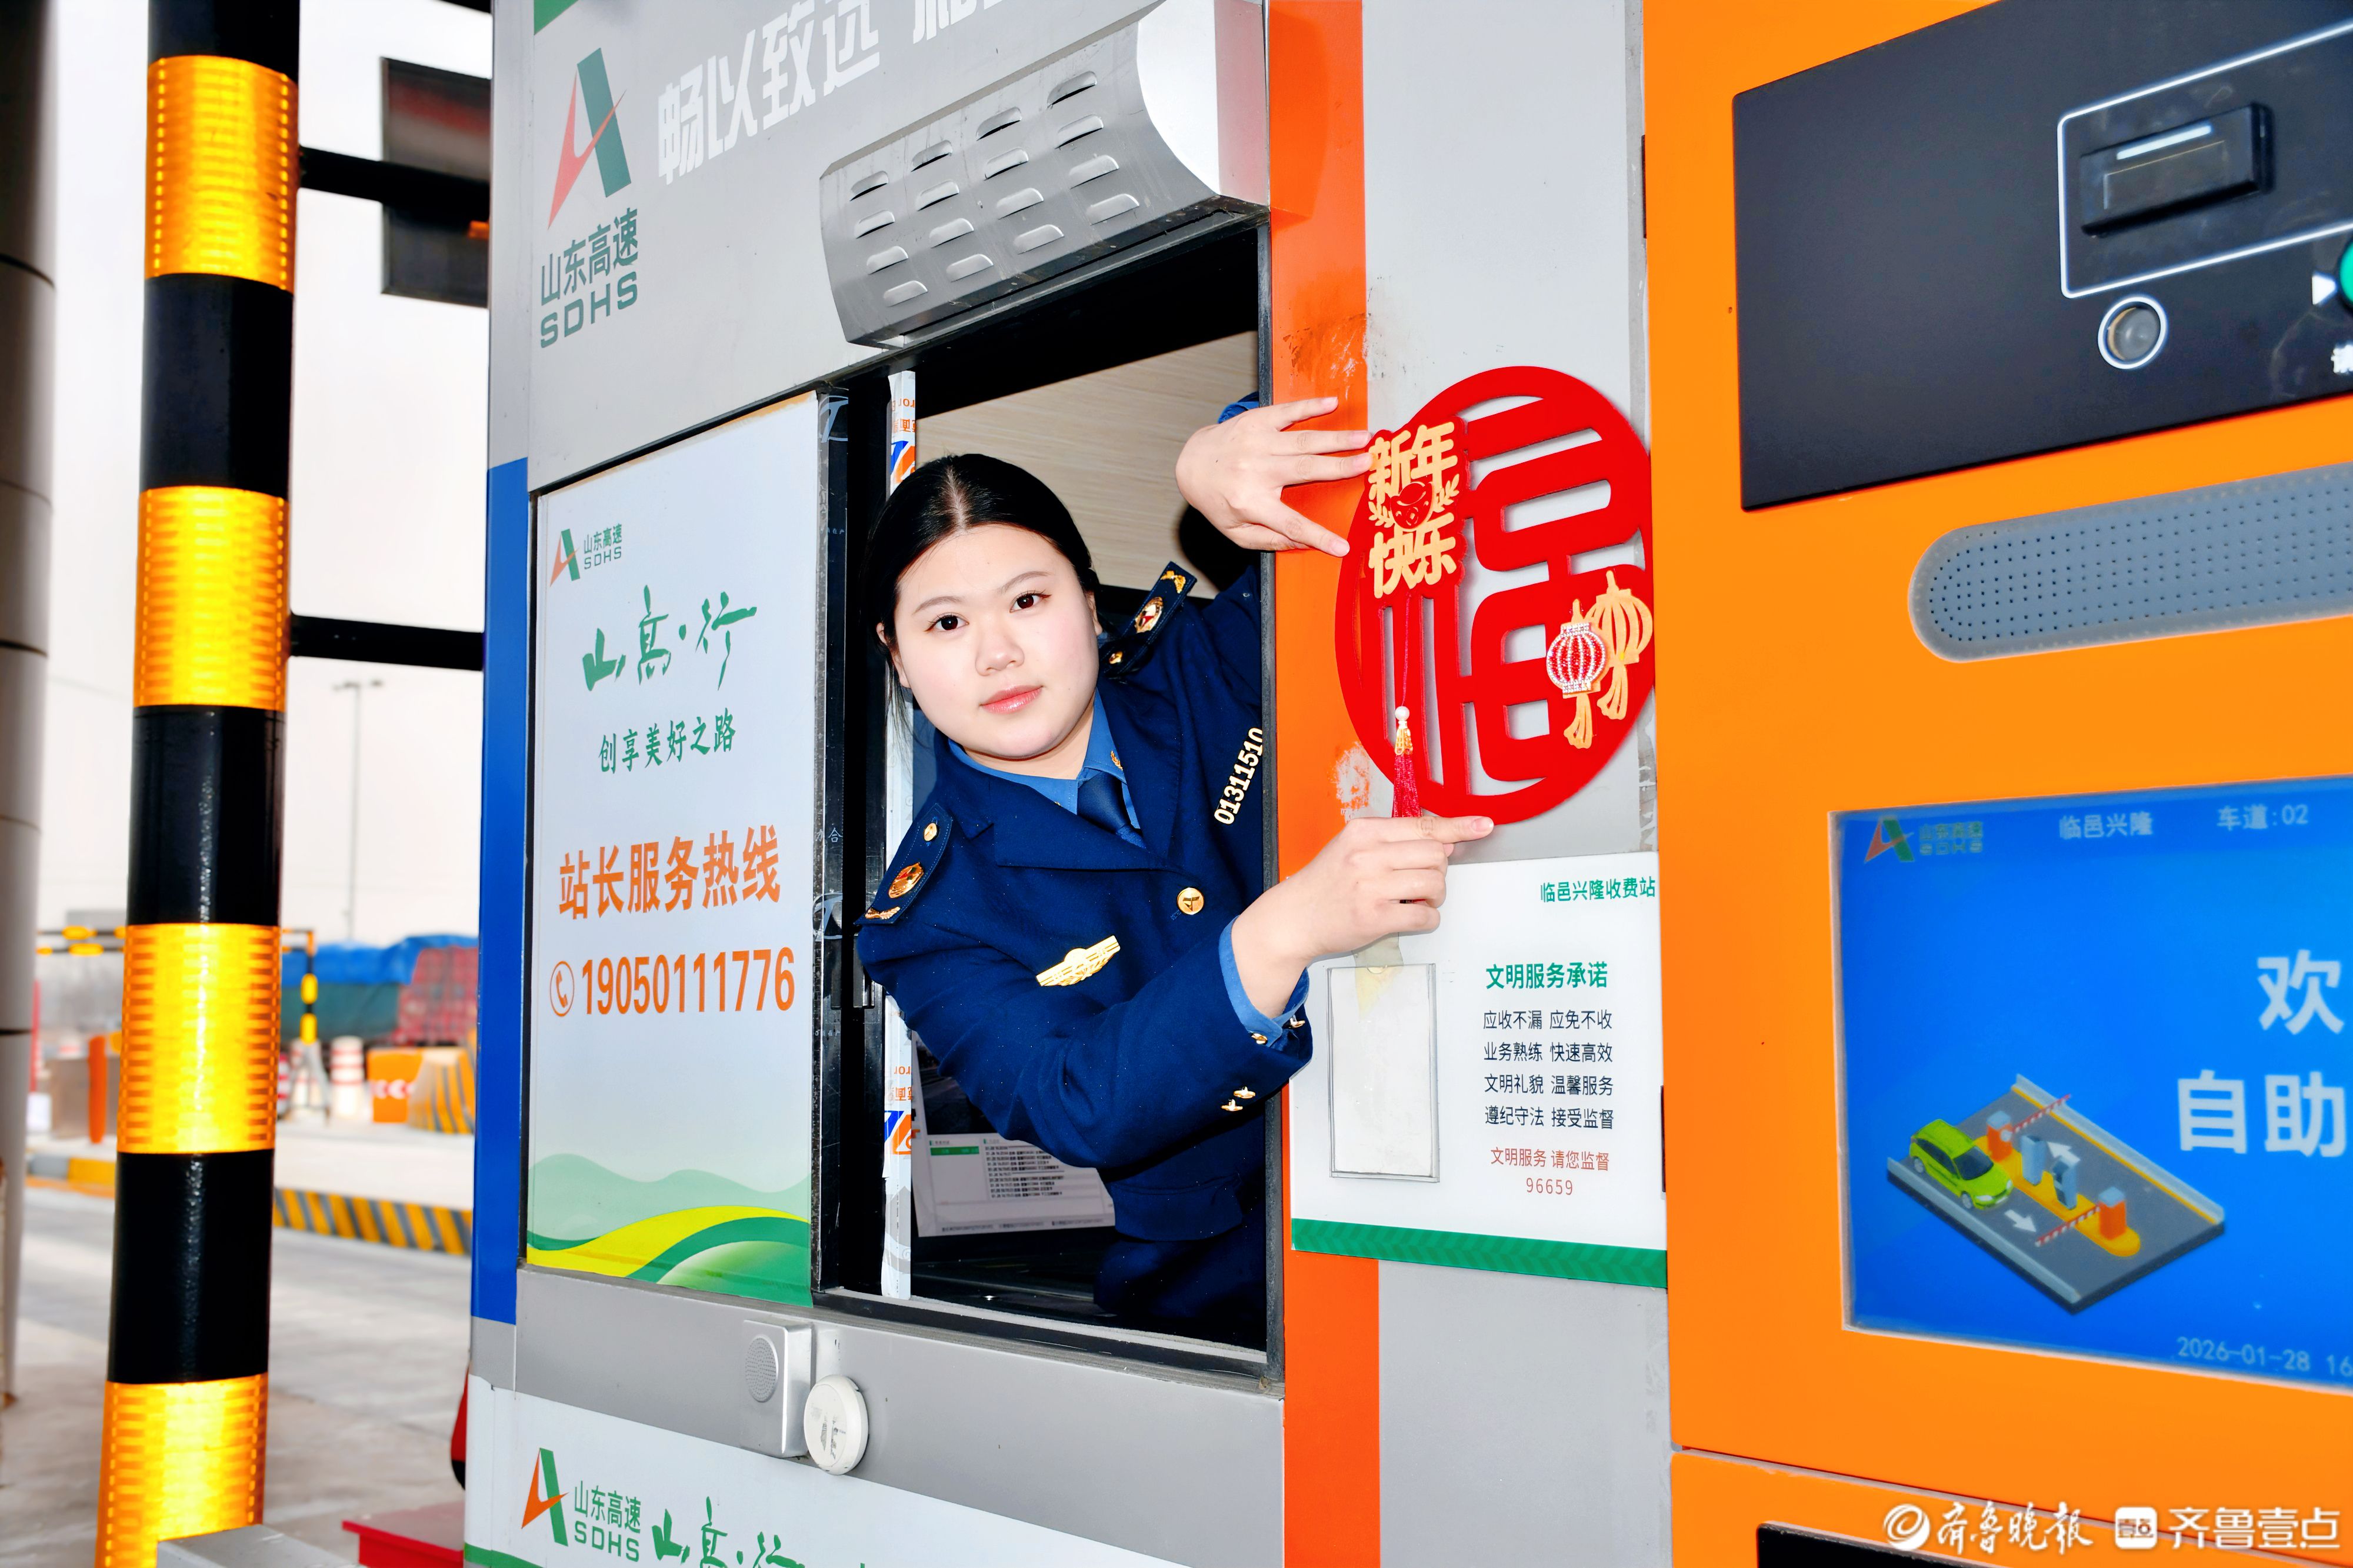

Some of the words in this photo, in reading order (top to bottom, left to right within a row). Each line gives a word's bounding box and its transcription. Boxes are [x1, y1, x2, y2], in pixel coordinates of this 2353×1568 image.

[658, 0, 880, 185] 畅以致远
[541, 208, 638, 306] 山东高速
[541, 271, 638, 348] SDHS
[1368, 421, 1459, 505] 新年
[583, 523, 622, 555] 山东高速
[584, 548, 622, 569] SDHS
[1368, 512, 1458, 599] 快乐
[599, 707, 736, 773] 创享美好之路
[1214, 728, 1263, 825] 01311510
[2059, 810, 2153, 840] 临邑兴隆
[2218, 804, 2308, 831] 车道:02
[558, 825, 780, 920] 站长服务热线
[1540, 876, 1657, 903] 临邑兴隆收费站
[582, 946, 795, 1015] 19050111776
[1485, 961, 1609, 990] 文明服务承诺
[2257, 949, 2344, 1035] 欢
[1483, 1009, 1543, 1030] 应收不漏
[1549, 1009, 1613, 1030] 应免不收
[1484, 1042, 1544, 1062] 业务熟练
[1549, 1042, 1614, 1063] 快速高效
[1484, 1073, 1544, 1095] 文明礼貌
[1551, 1075, 1614, 1097] 温馨服务
[1485, 1105, 1545, 1127] 遵纪守法
[1551, 1106, 1615, 1130] 接受监督
[2178, 1069, 2346, 1157] 自助
[1491, 1147, 1547, 1168] 文明服务
[1551, 1150, 1610, 1172] 请您监督
[1526, 1177, 1574, 1196] 96659
[2177, 1337, 2311, 1372] 2026-01-28
[574, 1480, 641, 1530] 山东高速
[574, 1520, 640, 1563] SDHS
